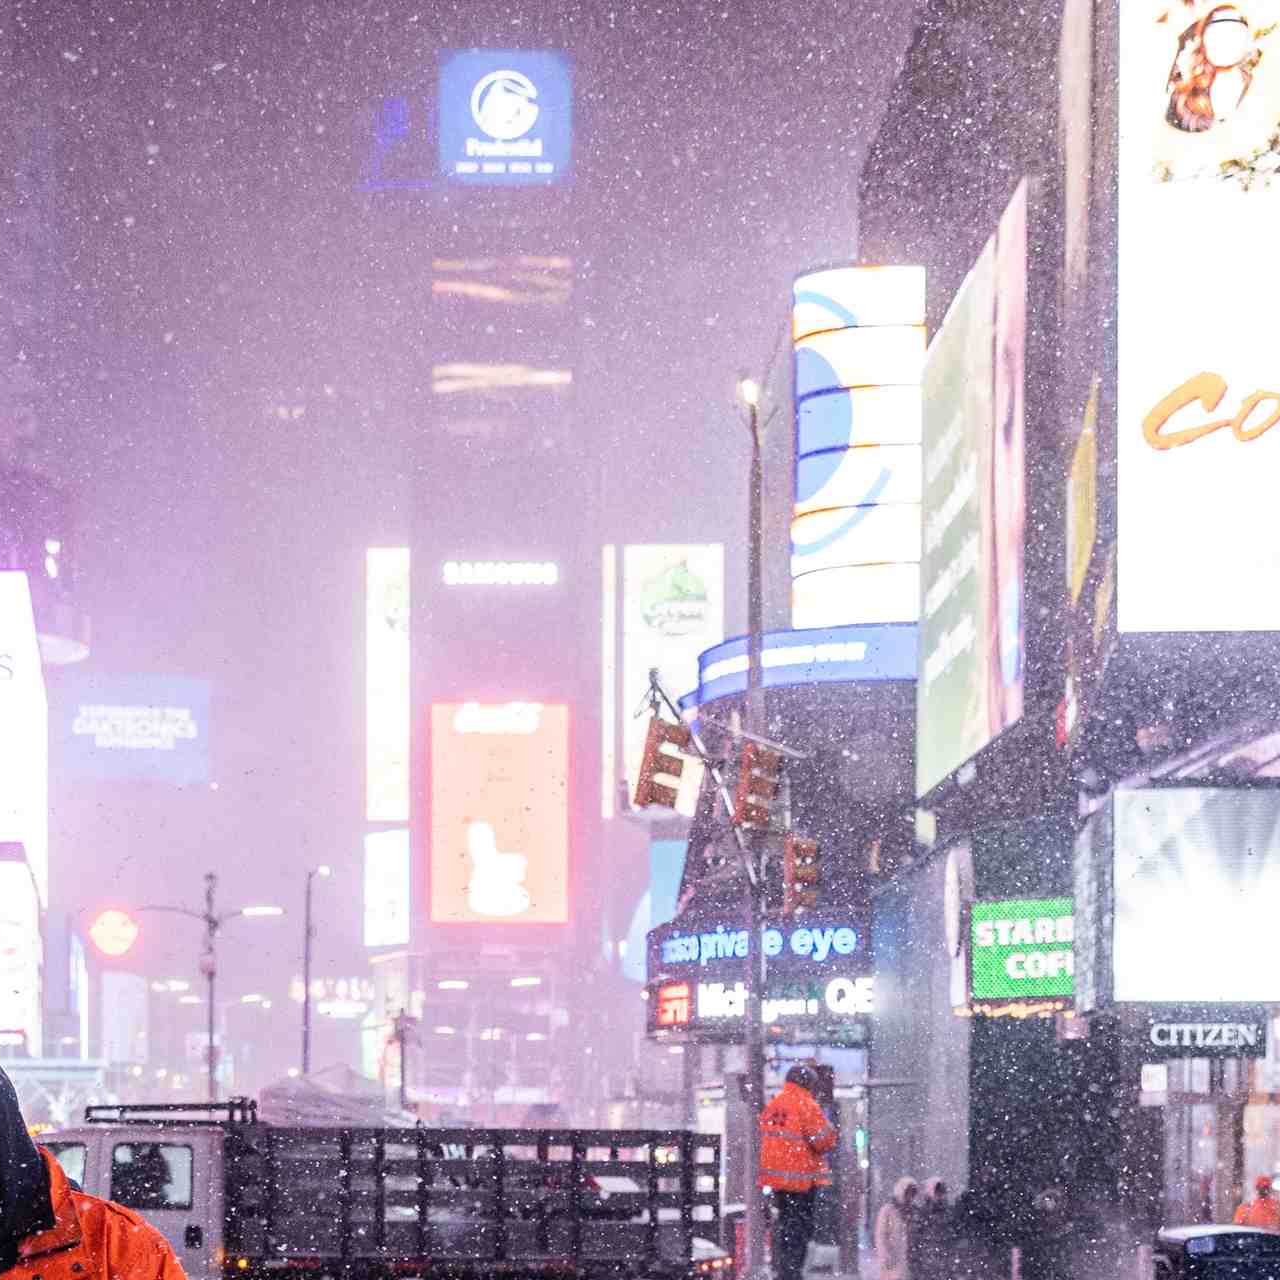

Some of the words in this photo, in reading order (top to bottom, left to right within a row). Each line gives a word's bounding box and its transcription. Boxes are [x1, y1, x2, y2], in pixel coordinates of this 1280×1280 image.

[700, 924, 783, 966] privae
[790, 927, 857, 962] eye
[1150, 1022, 1258, 1047] CITIZEN
